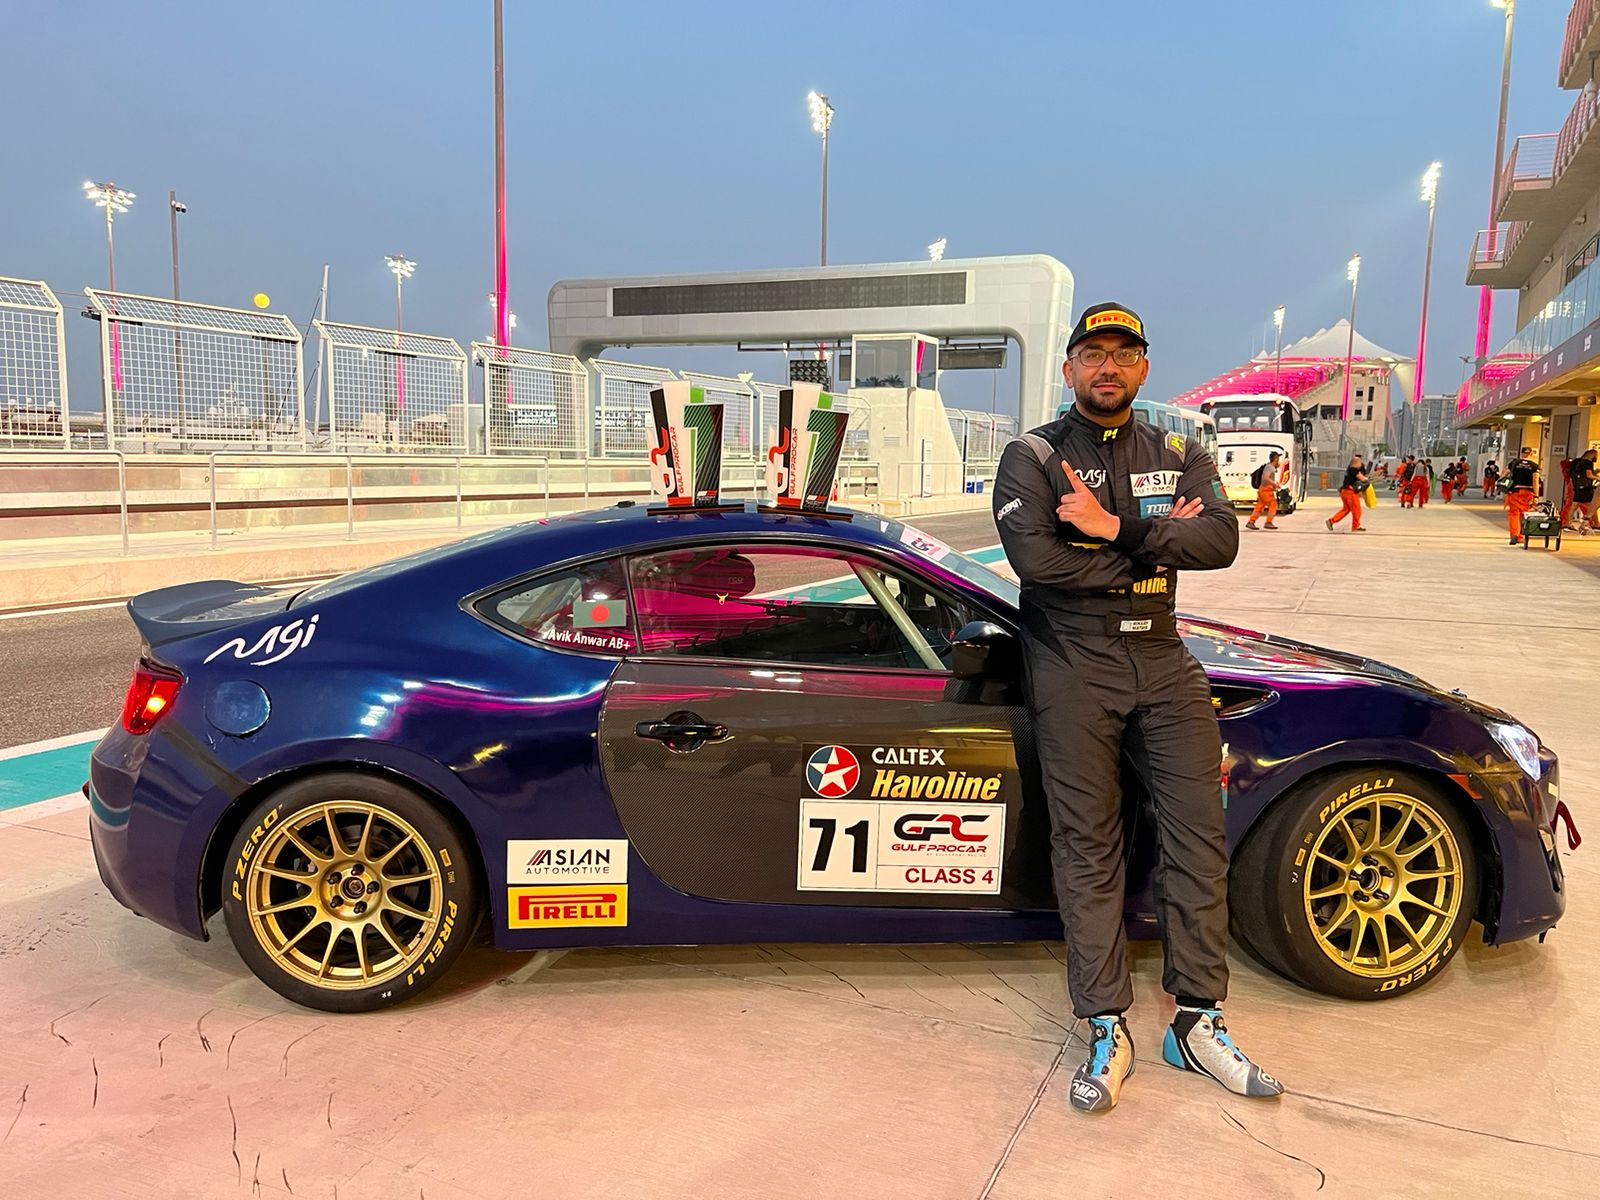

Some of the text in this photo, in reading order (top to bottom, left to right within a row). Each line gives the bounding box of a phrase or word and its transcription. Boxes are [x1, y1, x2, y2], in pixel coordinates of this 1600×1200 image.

[1134, 486, 1175, 494] AUTOMO
[548, 628, 631, 650] Avik Anwar AB+
[871, 747, 946, 766] CALTEX
[870, 769, 1002, 801] Havoline
[1319, 778, 1394, 824] PIRELLI
[809, 818, 869, 873] 71
[527, 849, 610, 866] ASIAN
[525, 866, 610, 875] AUTOMOTIVE
[905, 867, 994, 885] CLASS 4
[518, 893, 618, 921] PIRELLI
[407, 900, 458, 986] PIRELLI
